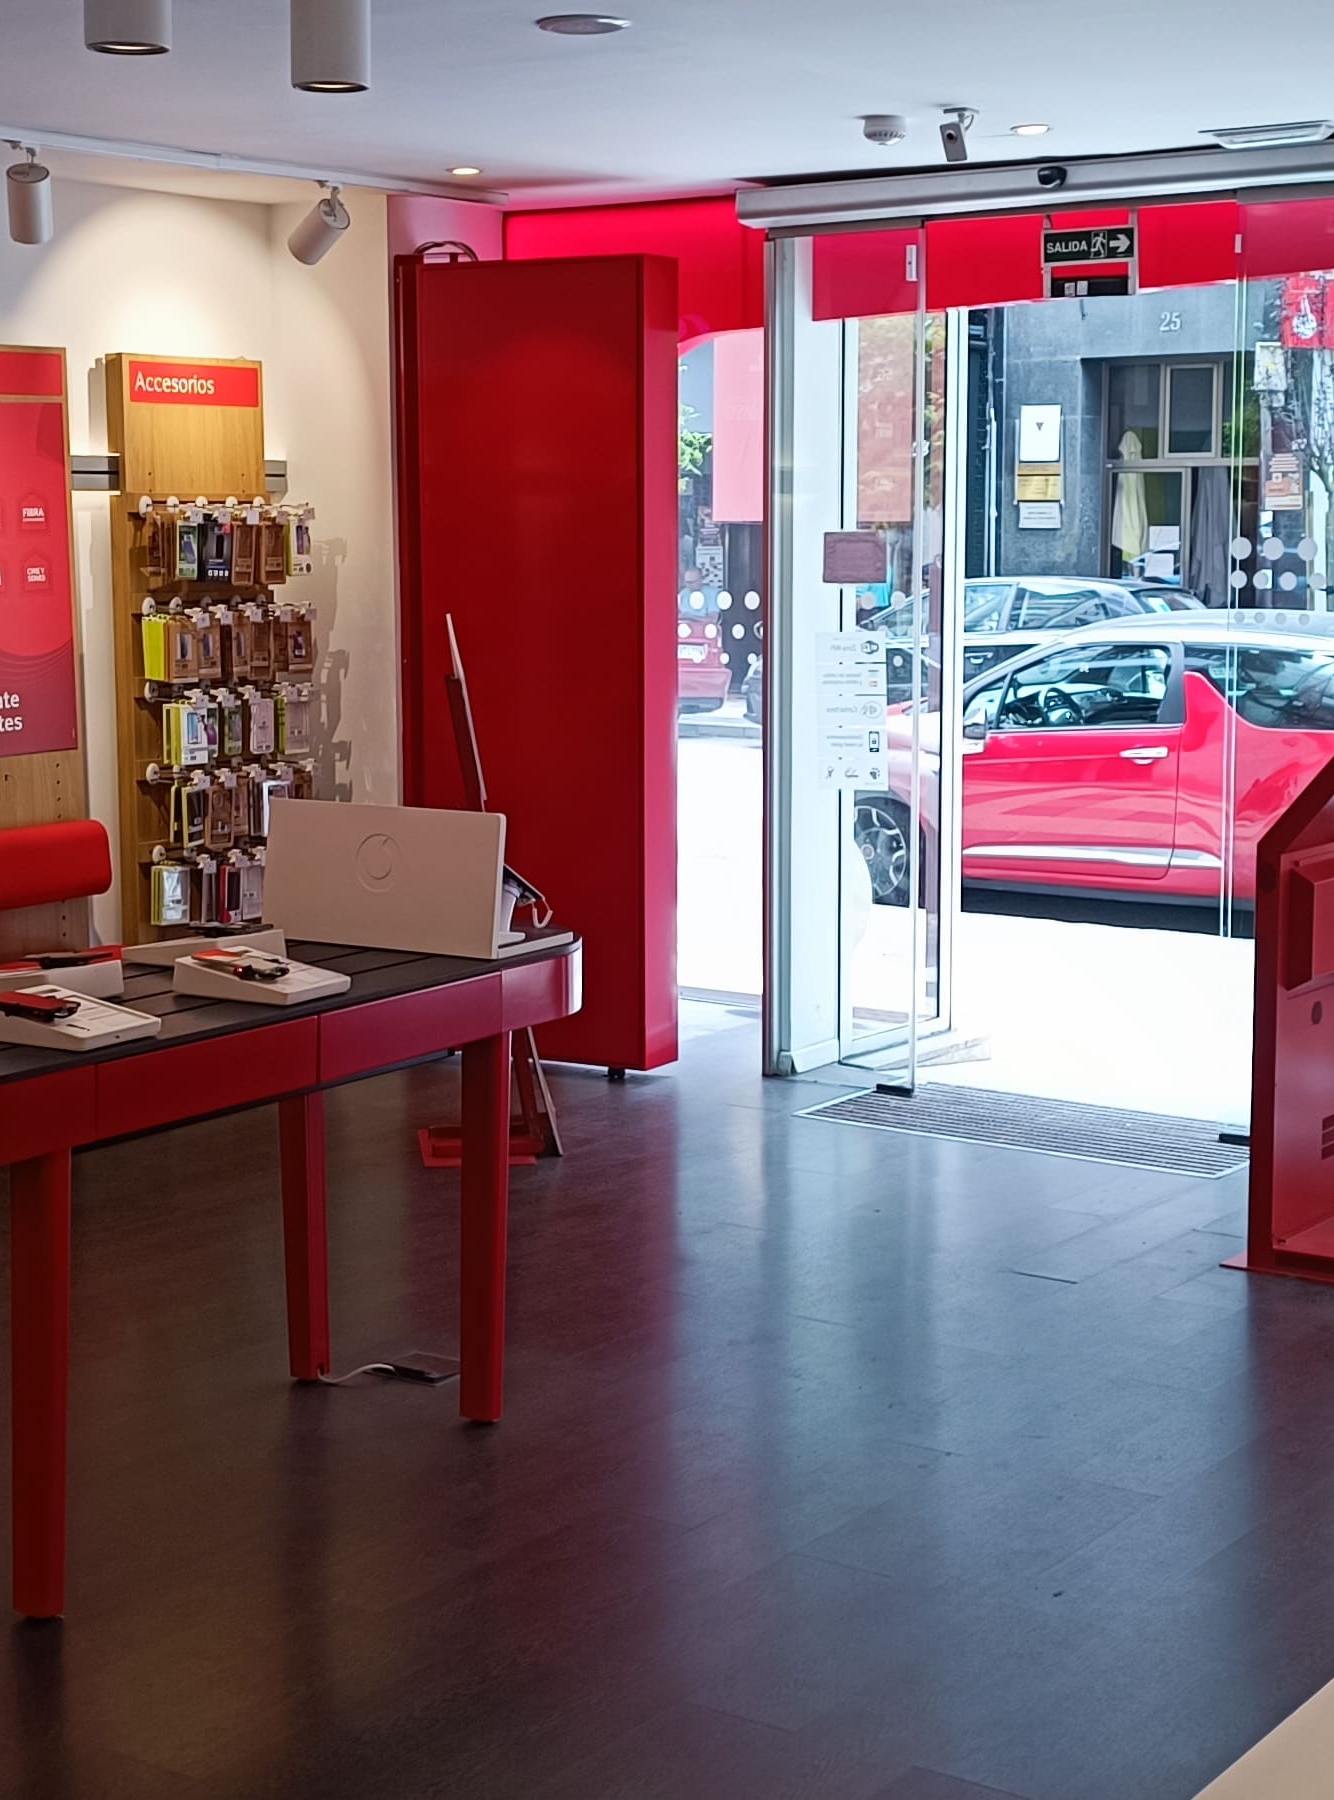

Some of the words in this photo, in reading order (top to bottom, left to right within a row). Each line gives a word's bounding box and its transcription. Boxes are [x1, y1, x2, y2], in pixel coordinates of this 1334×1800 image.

[1046, 240, 1088, 254] SALIDA
[1159, 311, 1181, 331] 25
[135, 370, 215, 395] Accesorios
[22, 507, 45, 517] FIBRA
